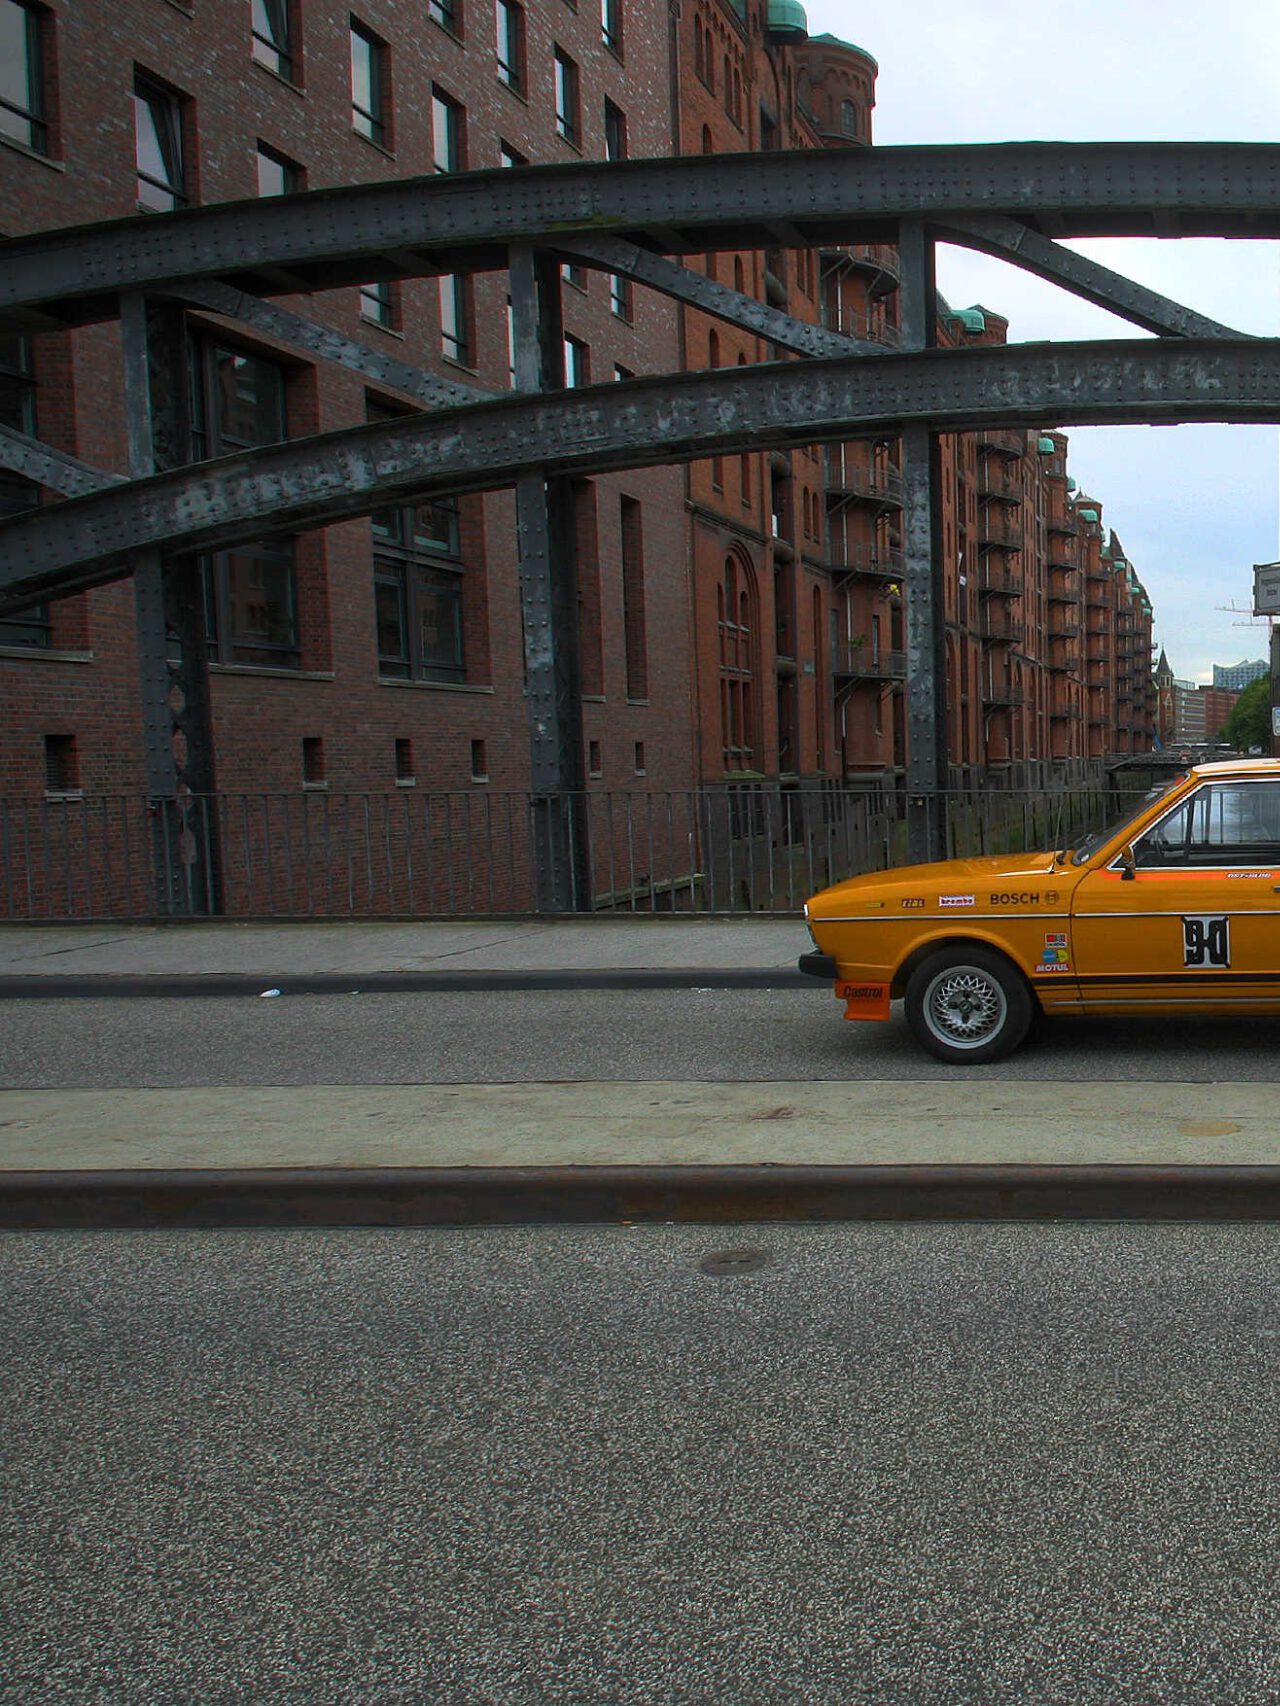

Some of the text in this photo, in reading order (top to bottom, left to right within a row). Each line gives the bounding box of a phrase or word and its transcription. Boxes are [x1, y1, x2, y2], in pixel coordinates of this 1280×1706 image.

[990, 893, 1040, 905] BOSCH
[1036, 963, 1069, 972] MOTUL
[844, 985, 883, 998] Castrol
